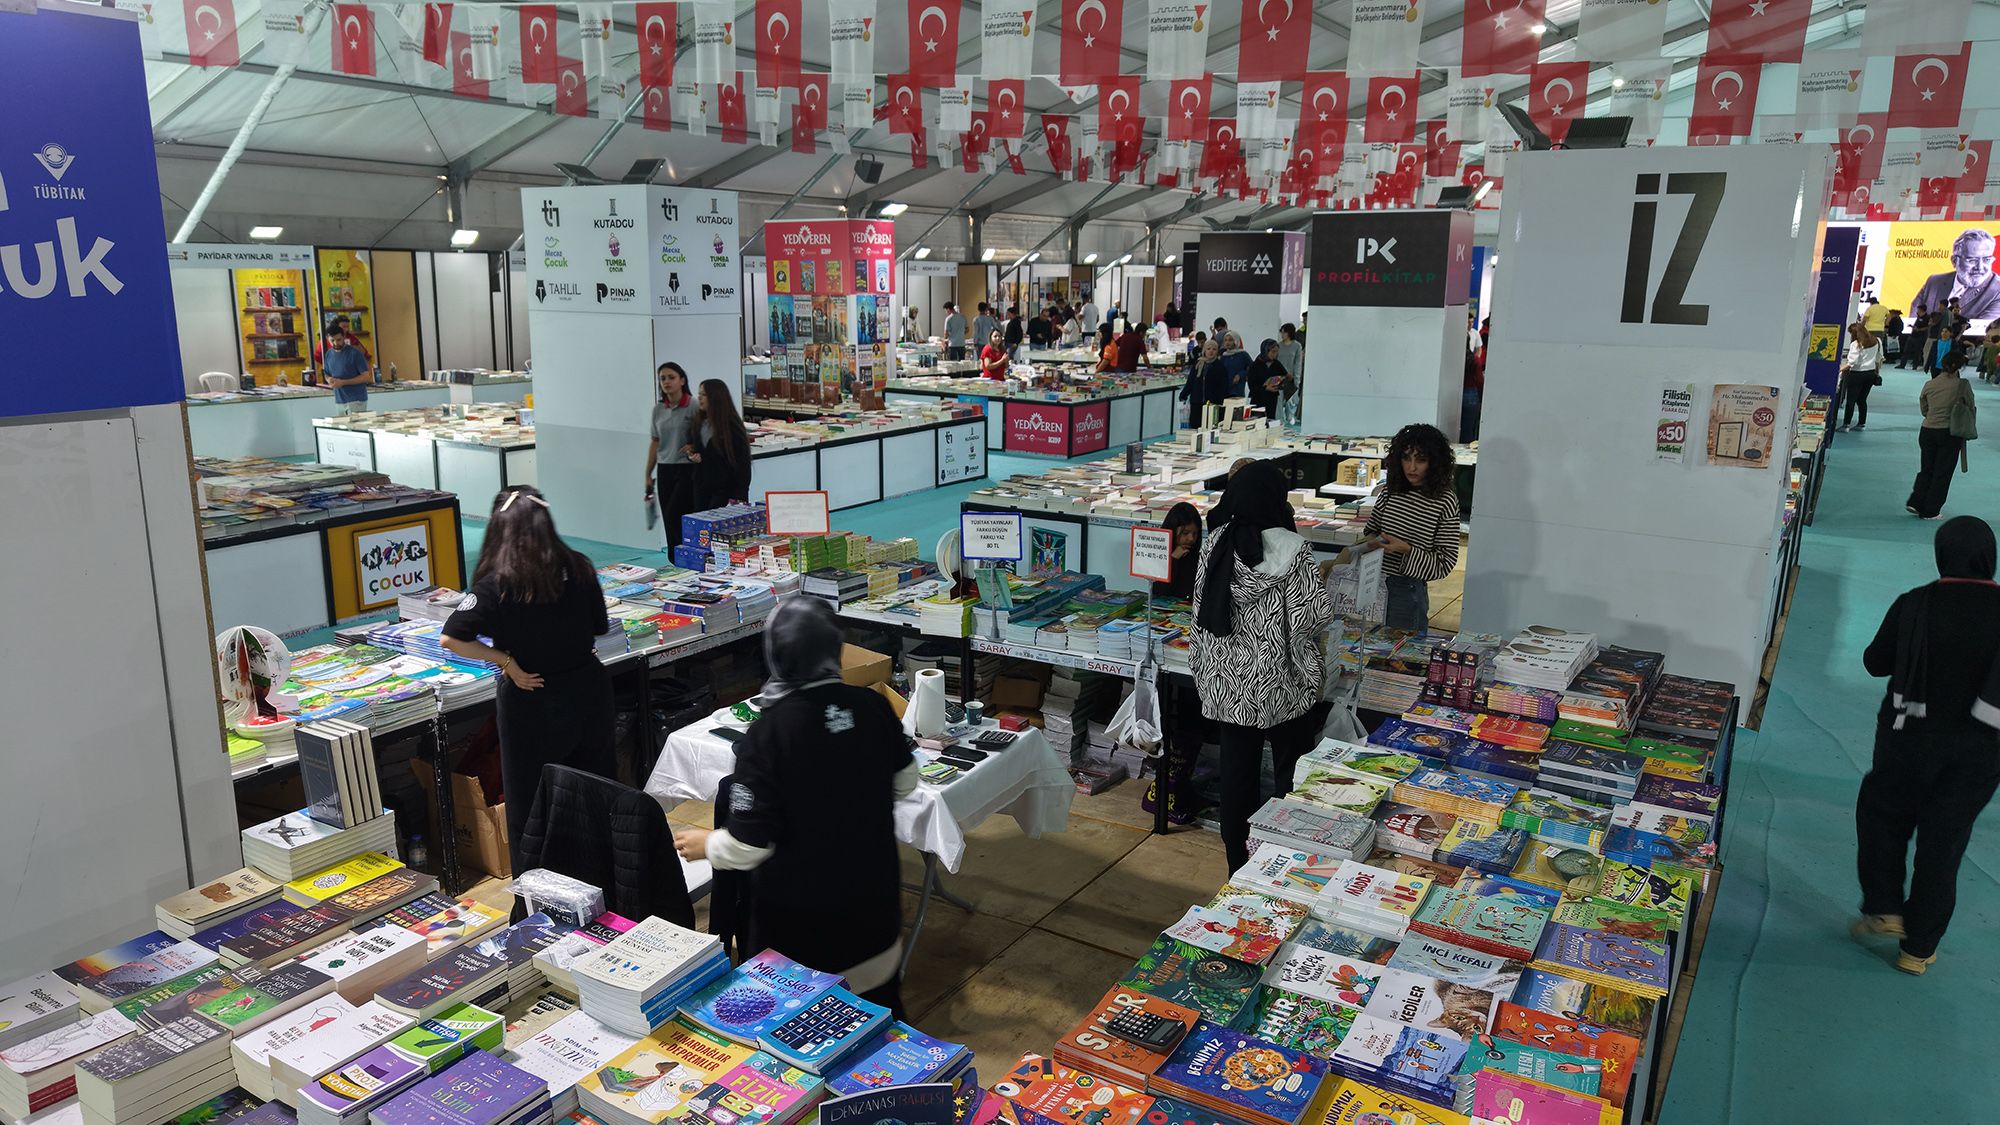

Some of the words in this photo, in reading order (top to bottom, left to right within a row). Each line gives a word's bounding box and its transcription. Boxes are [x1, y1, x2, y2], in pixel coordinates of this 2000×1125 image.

[1356, 4, 1407, 12] Kahramanmaraş
[33, 184, 86, 201] TÜBİTAK
[593, 218, 634, 229] KUTADGU
[696, 215, 733, 226] KUTADGU
[1895, 238, 1925, 247] BAHADIR
[197, 251, 232, 261] PAYİDAR
[234, 252, 274, 261] YAYINLARI
[661, 253, 686, 264] Çocuk
[709, 255, 730, 263] TUMBA
[1894, 249, 1950, 259] YENİŞEHİRLİOĞLU
[543, 257, 569, 269] Çocuk
[605, 258, 627, 267] TUMBA
[1206, 255, 1248, 272] YEDİTEPE
[610, 288, 636, 298] PINAR
[713, 287, 735, 295] PINAR
[1662, 389, 1692, 401] Filistin
[1753, 411, 1774, 422] %50
[1658, 425, 1686, 441] %50
[366, 544, 421, 567] NAR
[368, 570, 425, 596] ÇOCUK
[979, 643, 1012, 655] SARAY
[1087, 661, 1123, 674] SARAY
[1344, 871, 1375, 897] MADDE
[620, 938, 653, 954] DÜNYASI
[1421, 941, 1450, 958] İNCİ
[1452, 953, 1493, 970] KEFALİ
[745, 970, 777, 990] Hakkında
[752, 961, 816, 994] Mikroskop
[1399, 984, 1426, 1024] KEDİLER
[424, 1019, 459, 1040] İLETİŞİM
[447, 1020, 484, 1029] ETKİLİ
[563, 1037, 582, 1049] ADIM
[581, 1045, 599, 1056] ADIM
[669, 1030, 732, 1063] YANARDAĞLAR
[666, 1040, 720, 1072] DEPREMLER
[1187, 1037, 1224, 1078] BEYNİMİZ
[349, 1067, 381, 1089] PROJE
[729, 1074, 787, 1107] FİZİK
